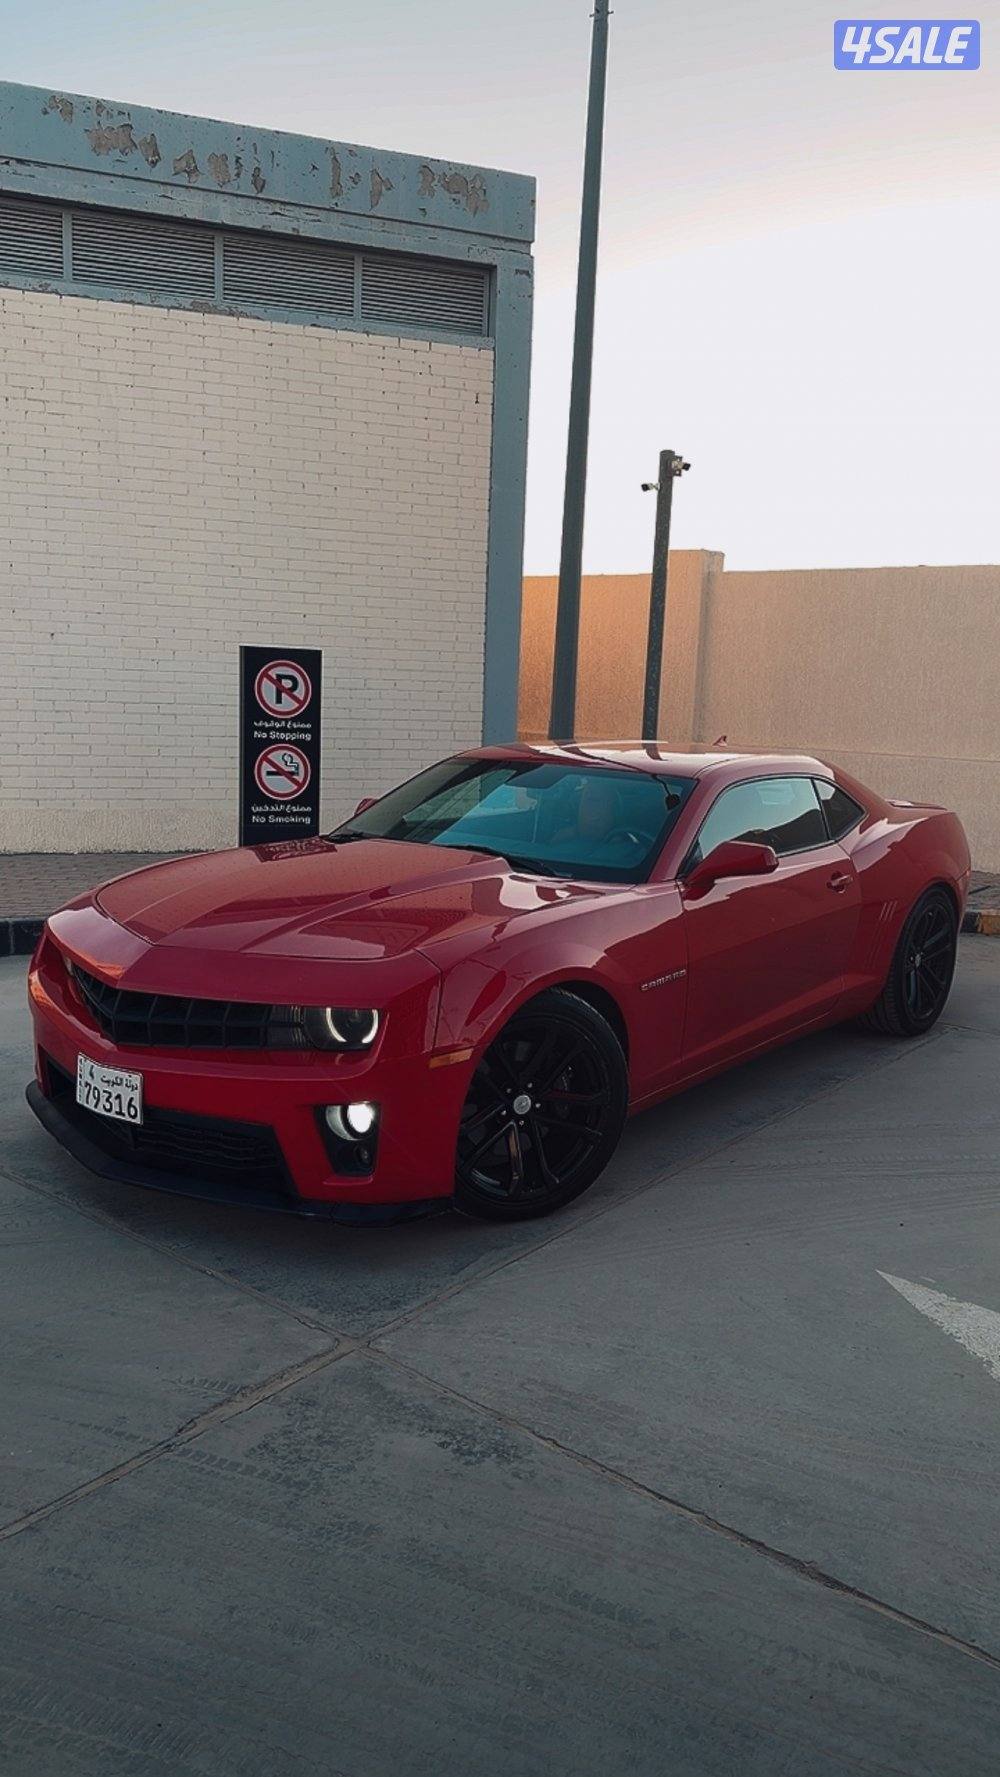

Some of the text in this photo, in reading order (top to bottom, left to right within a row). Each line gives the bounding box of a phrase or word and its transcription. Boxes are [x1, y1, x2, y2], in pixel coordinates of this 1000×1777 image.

[286, 720, 312, 729] ممنوع
[253, 730, 312, 741] No Stopping
[251, 803, 312, 813] ممنوع التدخين
[252, 814, 311, 825] No Smoking
[84, 1081, 138, 1120] 79316
